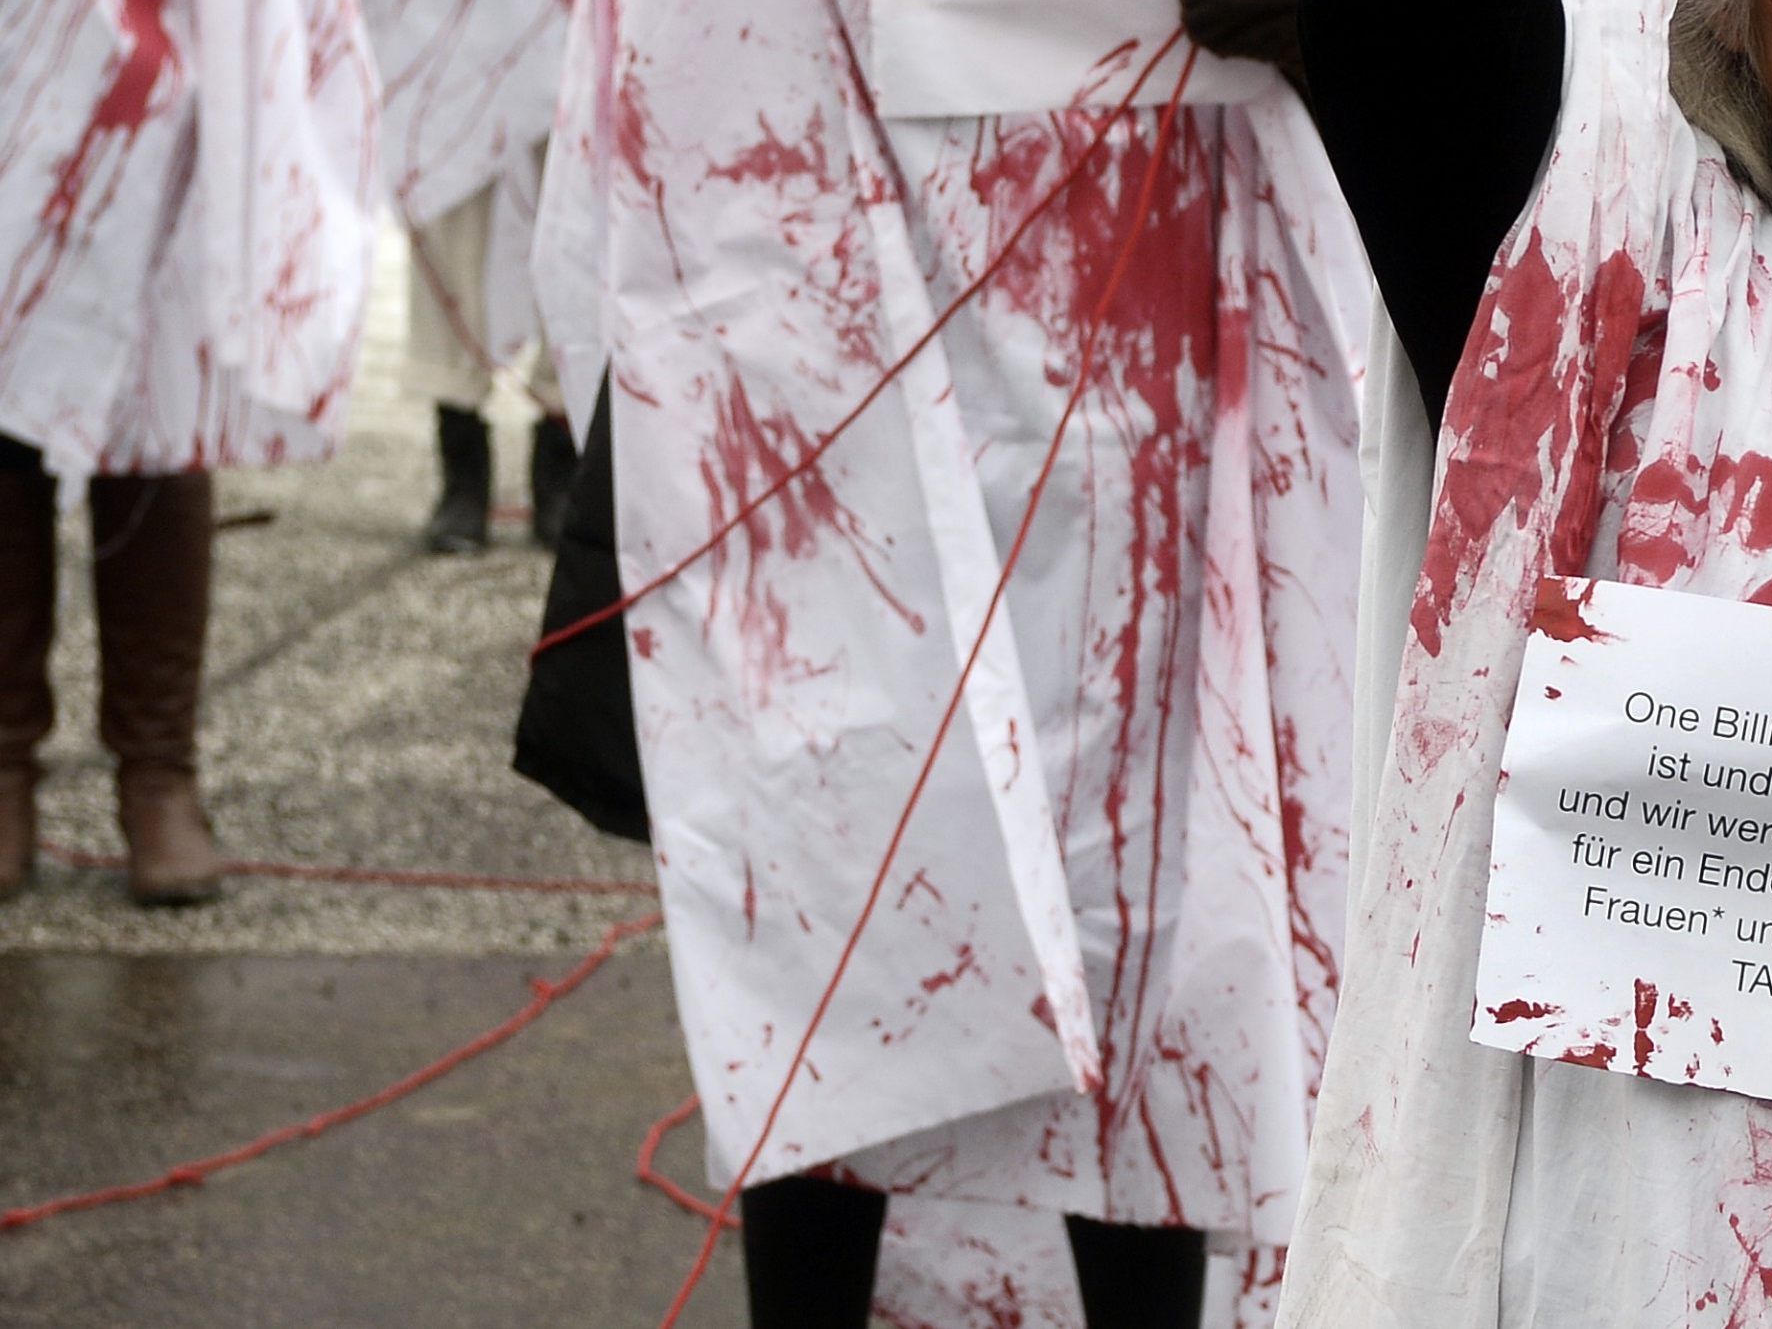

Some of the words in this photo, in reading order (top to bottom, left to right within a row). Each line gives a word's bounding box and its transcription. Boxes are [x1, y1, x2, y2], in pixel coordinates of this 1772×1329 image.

[1624, 691, 1700, 732] One
[1648, 745, 1692, 783] ist
[1559, 788, 1630, 821] und
[1642, 799, 1697, 831] wir
[1572, 833, 1622, 870] für
[1632, 845, 1684, 881] ein
